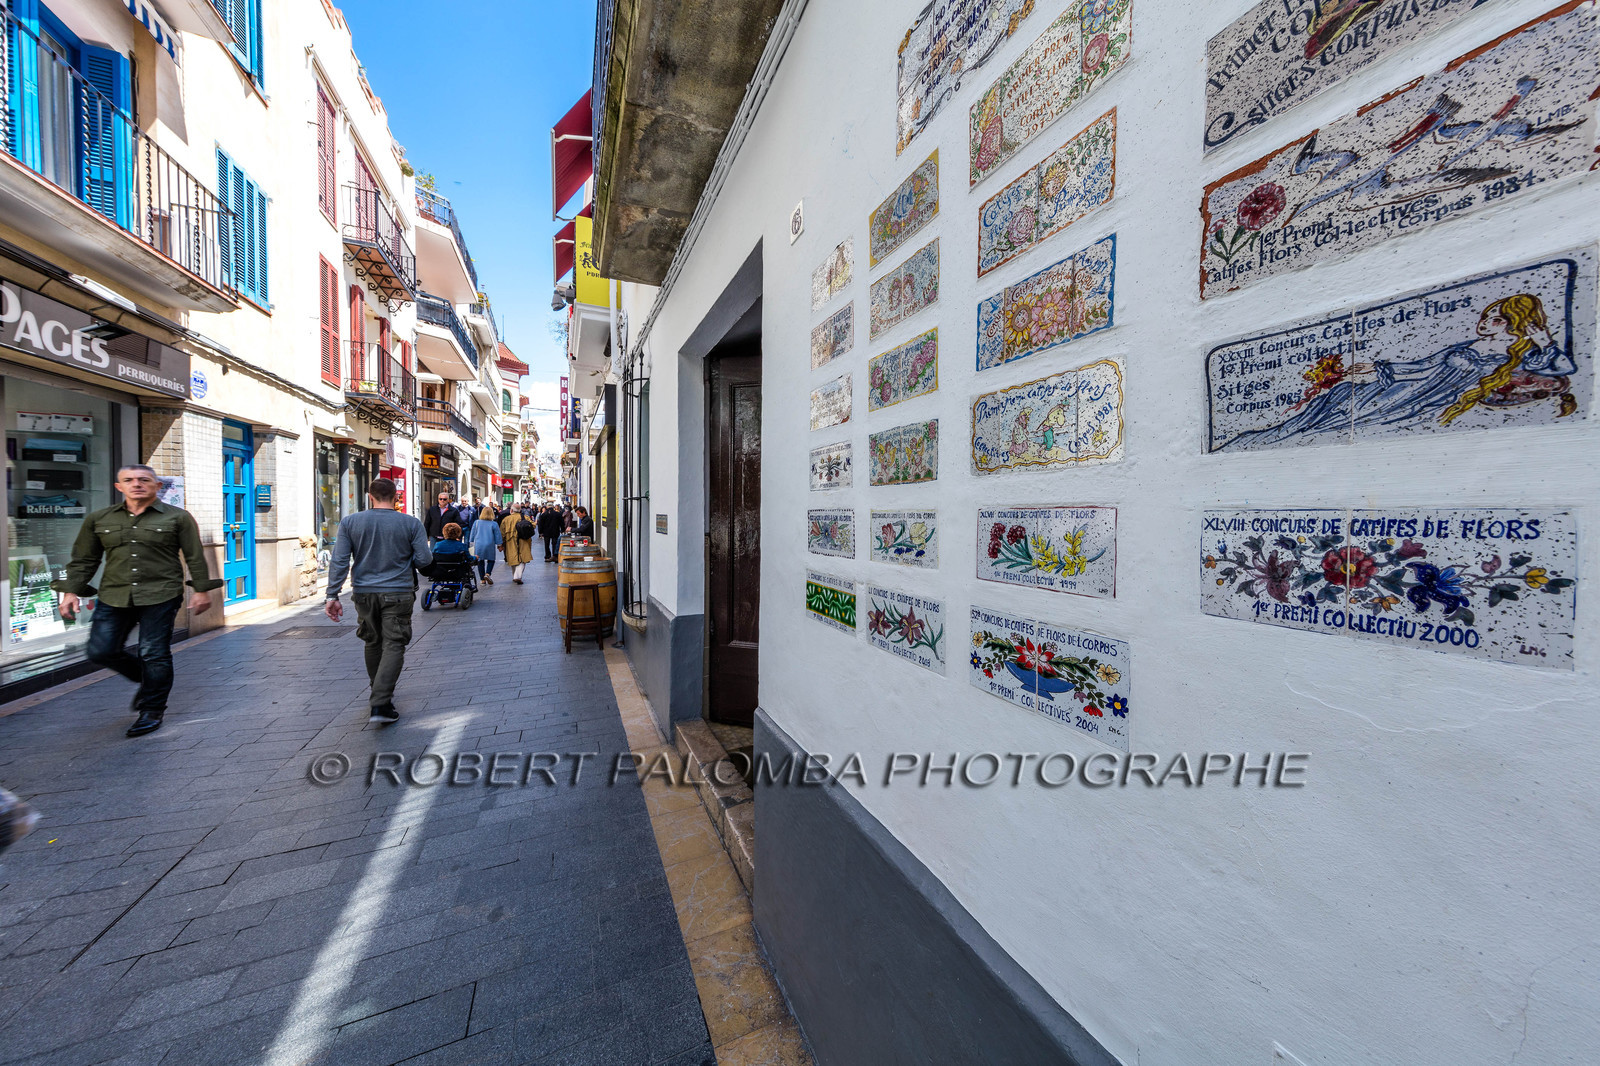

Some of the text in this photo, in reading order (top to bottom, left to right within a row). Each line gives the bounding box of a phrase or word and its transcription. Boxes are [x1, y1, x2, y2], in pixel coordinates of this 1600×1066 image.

[968, 18, 989, 49] 2000
[922, 40, 953, 84] CORPUS
[1007, 56, 1040, 99] PRIMER
[1043, 32, 1073, 60] PREMI
[1207, 10, 1277, 92] Primer
[1222, 0, 1419, 135] SITGES CORPUS
[1020, 89, 1060, 127] CORPUS
[1483, 169, 1538, 202] 1984
[1282, 212, 1333, 246] Premi
[1207, 258, 1252, 285] Catifes
[1259, 242, 1302, 267] Flors
[1218, 295, 1472, 363] XXXIII Concurs Catifes de flors
[1240, 356, 1282, 375] Premi
[1217, 381, 1270, 400] Sitges
[1227, 389, 1302, 414] Corpus 1985
[1095, 402, 1113, 423] 1981
[1054, 510, 1064, 519] DE
[1069, 509, 1096, 519] FLORS
[1252, 517, 1316, 534] CONCURS
[1322, 518, 1342, 535] DE
[1350, 516, 1417, 538] CATIFES
[1423, 519, 1448, 538] DE
[1461, 519, 1541, 540] FLORS
[1002, 571, 1020, 582] PREMI
[1059, 579, 1077, 590] 1999
[872, 587, 888, 599] CONCURS
[890, 591, 895, 601] DE
[914, 597, 920, 608] DE
[922, 599, 940, 614] FLORS
[980, 611, 1003, 628] CONCURS
[1003, 617, 1010, 629] DE
[1045, 628, 1066, 644] FLORS
[1081, 636, 1118, 657] CORPUS
[1253, 601, 1269, 616] 1er
[1274, 604, 1318, 624] PREMI
[1419, 623, 1480, 648] 2000
[997, 683, 1014, 700] PREMI
[1075, 714, 1099, 736] 2004
